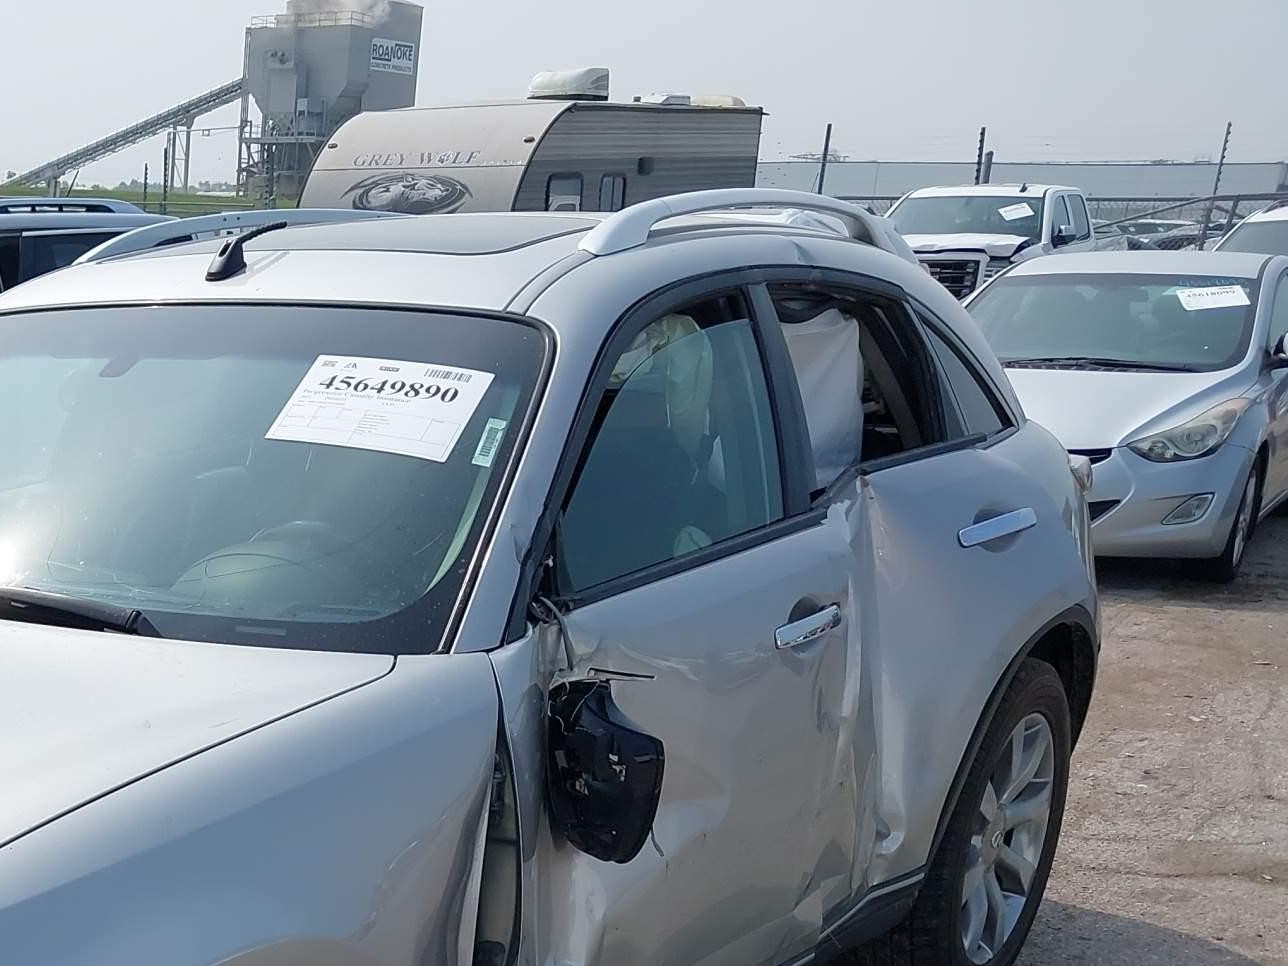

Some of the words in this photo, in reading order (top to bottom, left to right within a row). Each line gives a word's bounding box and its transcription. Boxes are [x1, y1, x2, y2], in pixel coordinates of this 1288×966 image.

[372, 44, 413, 61] ROANOKE
[353, 152, 406, 167] GREY
[318, 374, 459, 403] 45649890
